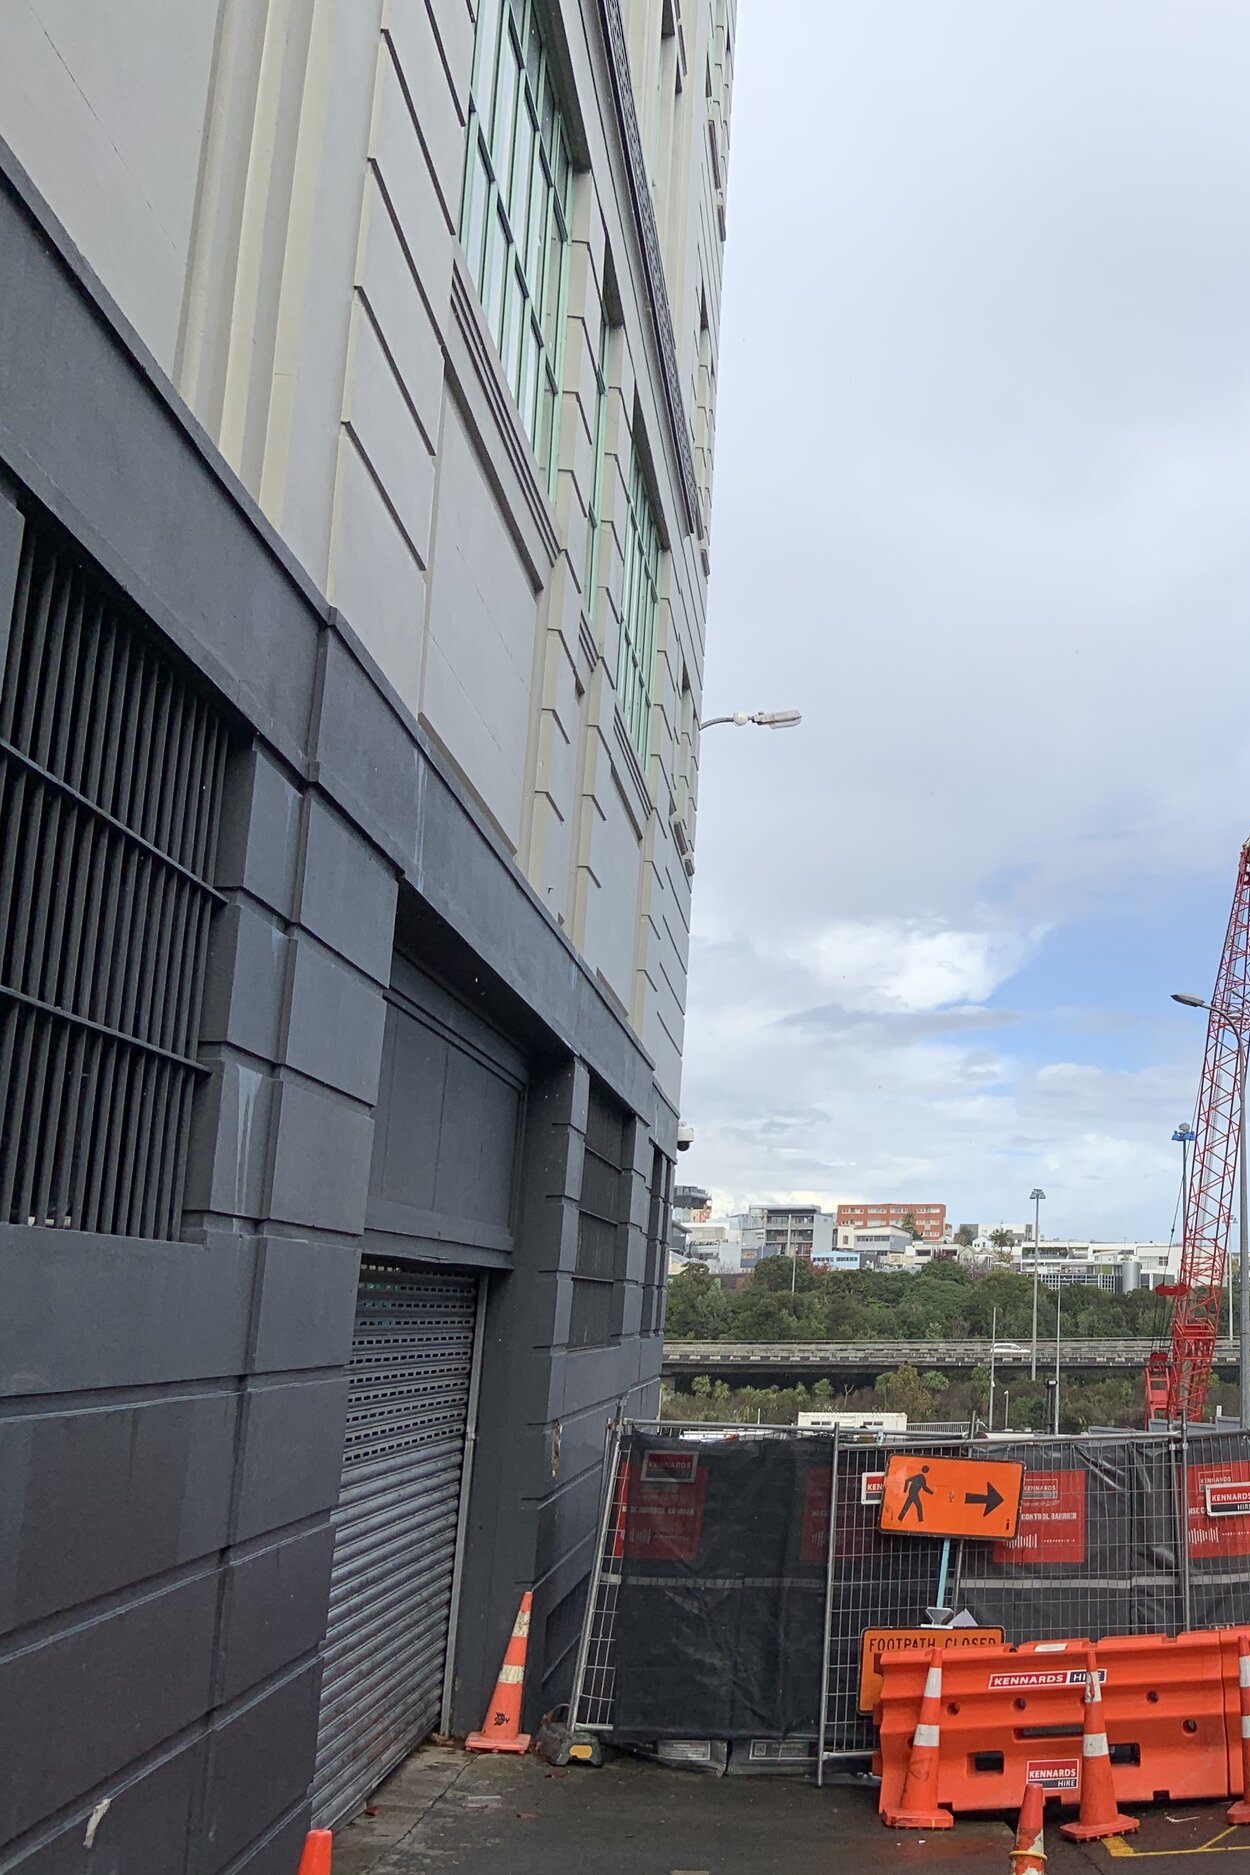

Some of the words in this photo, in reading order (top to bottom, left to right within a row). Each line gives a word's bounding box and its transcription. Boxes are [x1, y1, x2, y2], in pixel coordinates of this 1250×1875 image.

[869, 1638, 936, 1652] FOOTPATH
[994, 1674, 1065, 1686] KENNARDS
[1029, 1768, 1077, 1779] KENNARDS
[1057, 1779, 1076, 1787] HIRE
